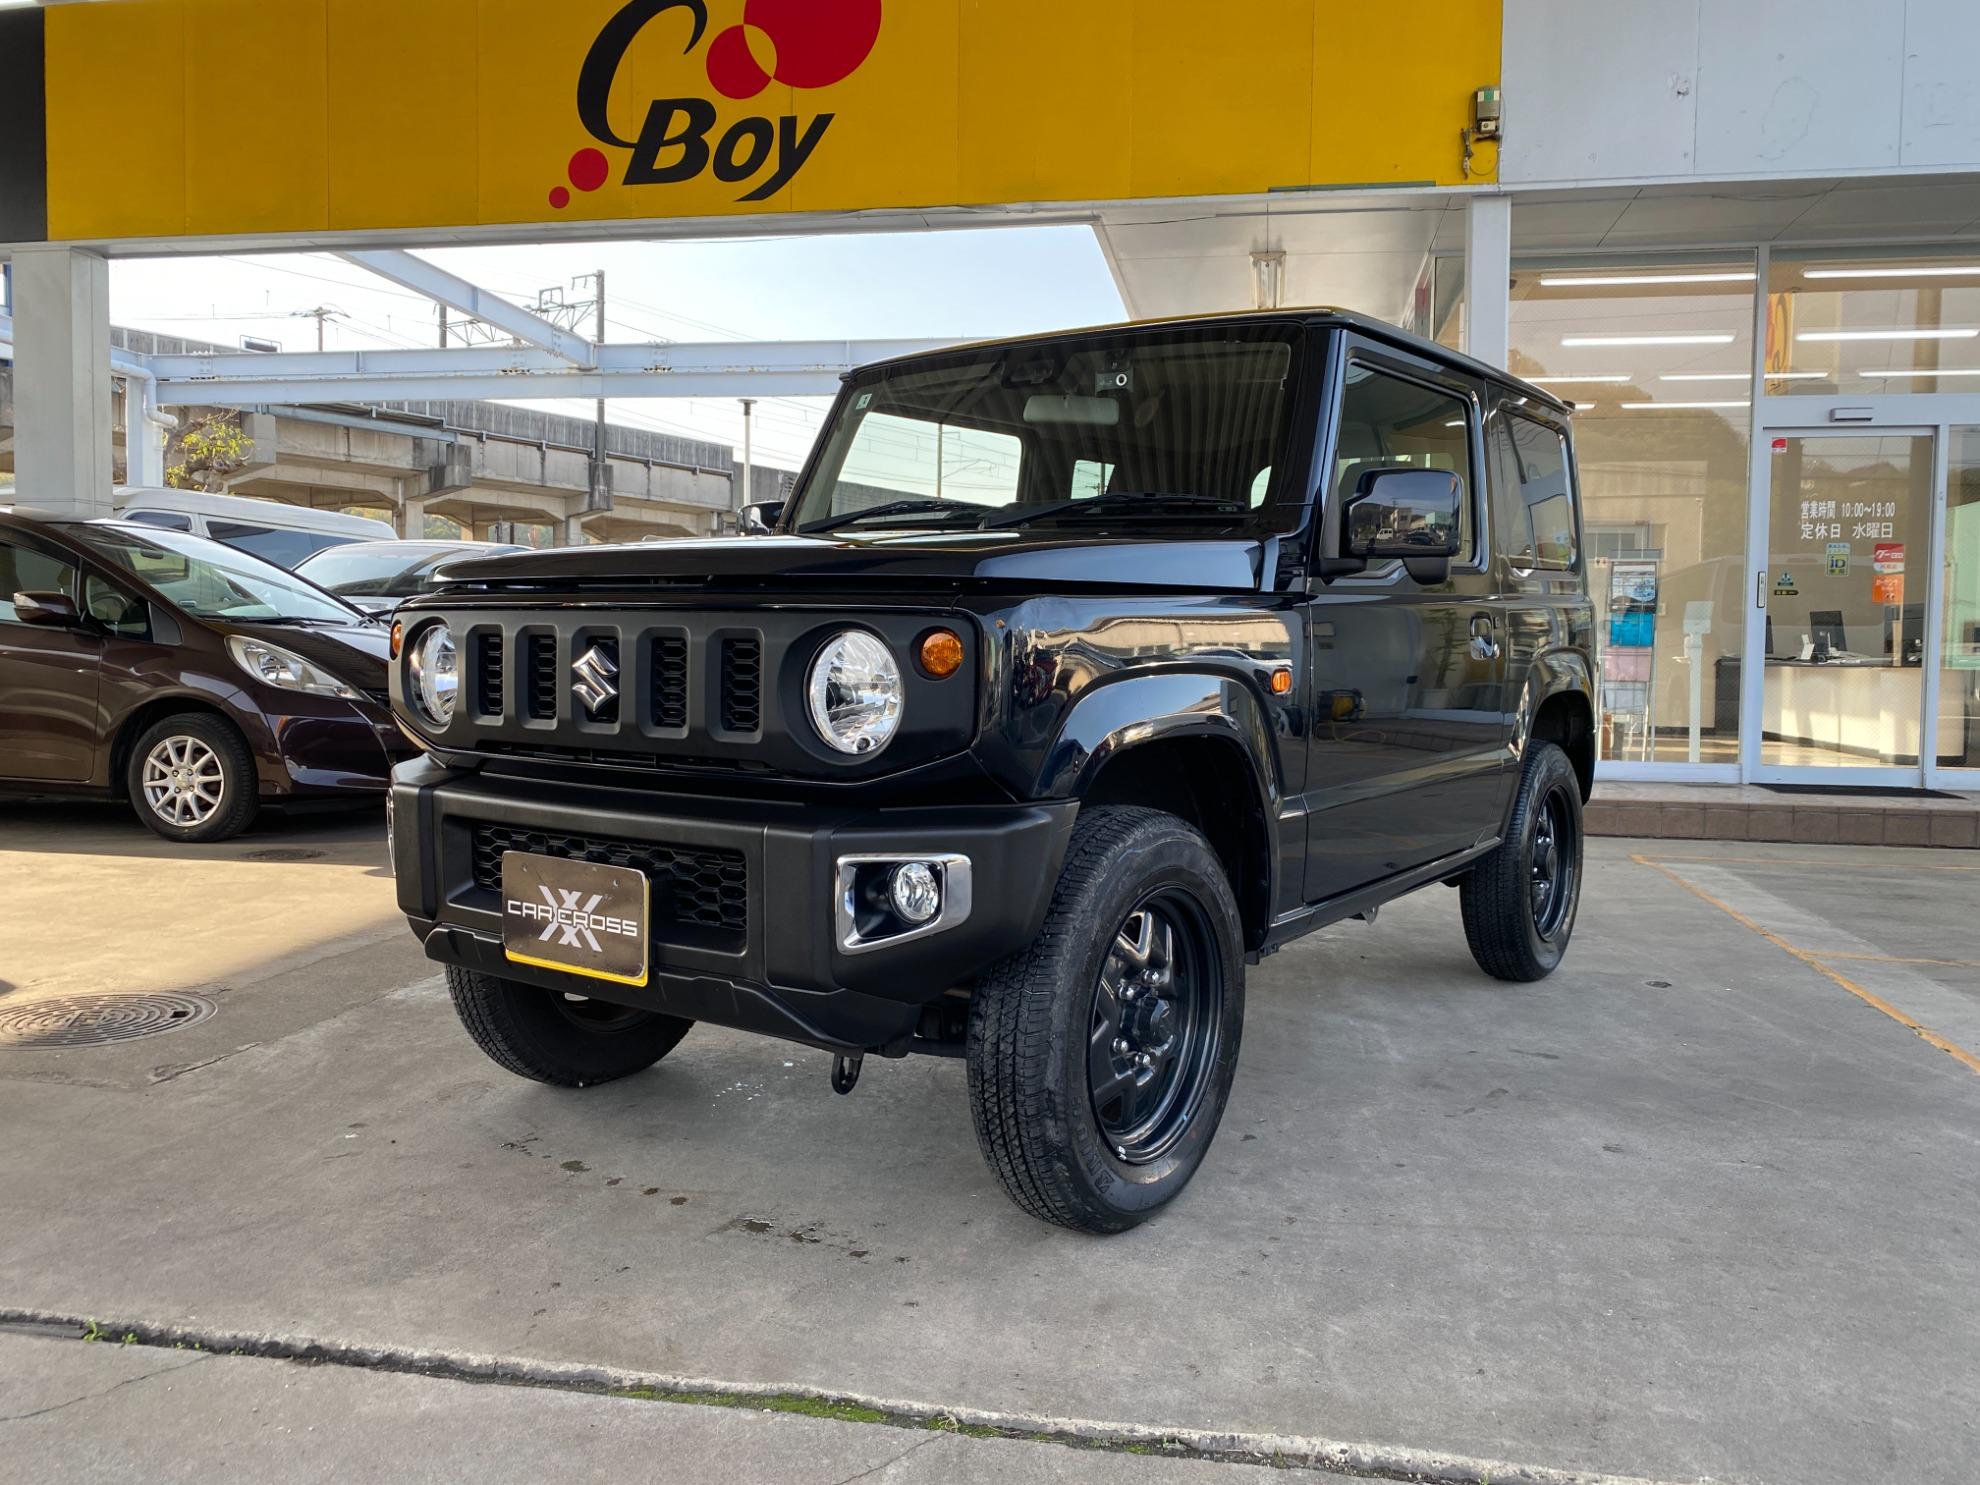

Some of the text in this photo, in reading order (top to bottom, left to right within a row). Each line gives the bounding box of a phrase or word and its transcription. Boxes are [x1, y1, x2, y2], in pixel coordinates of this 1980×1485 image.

[1800, 500, 1836, 519] 営業時間
[1800, 522, 1893, 540] 定休日 水曜日
[507, 900, 638, 937] CAR CROSS
